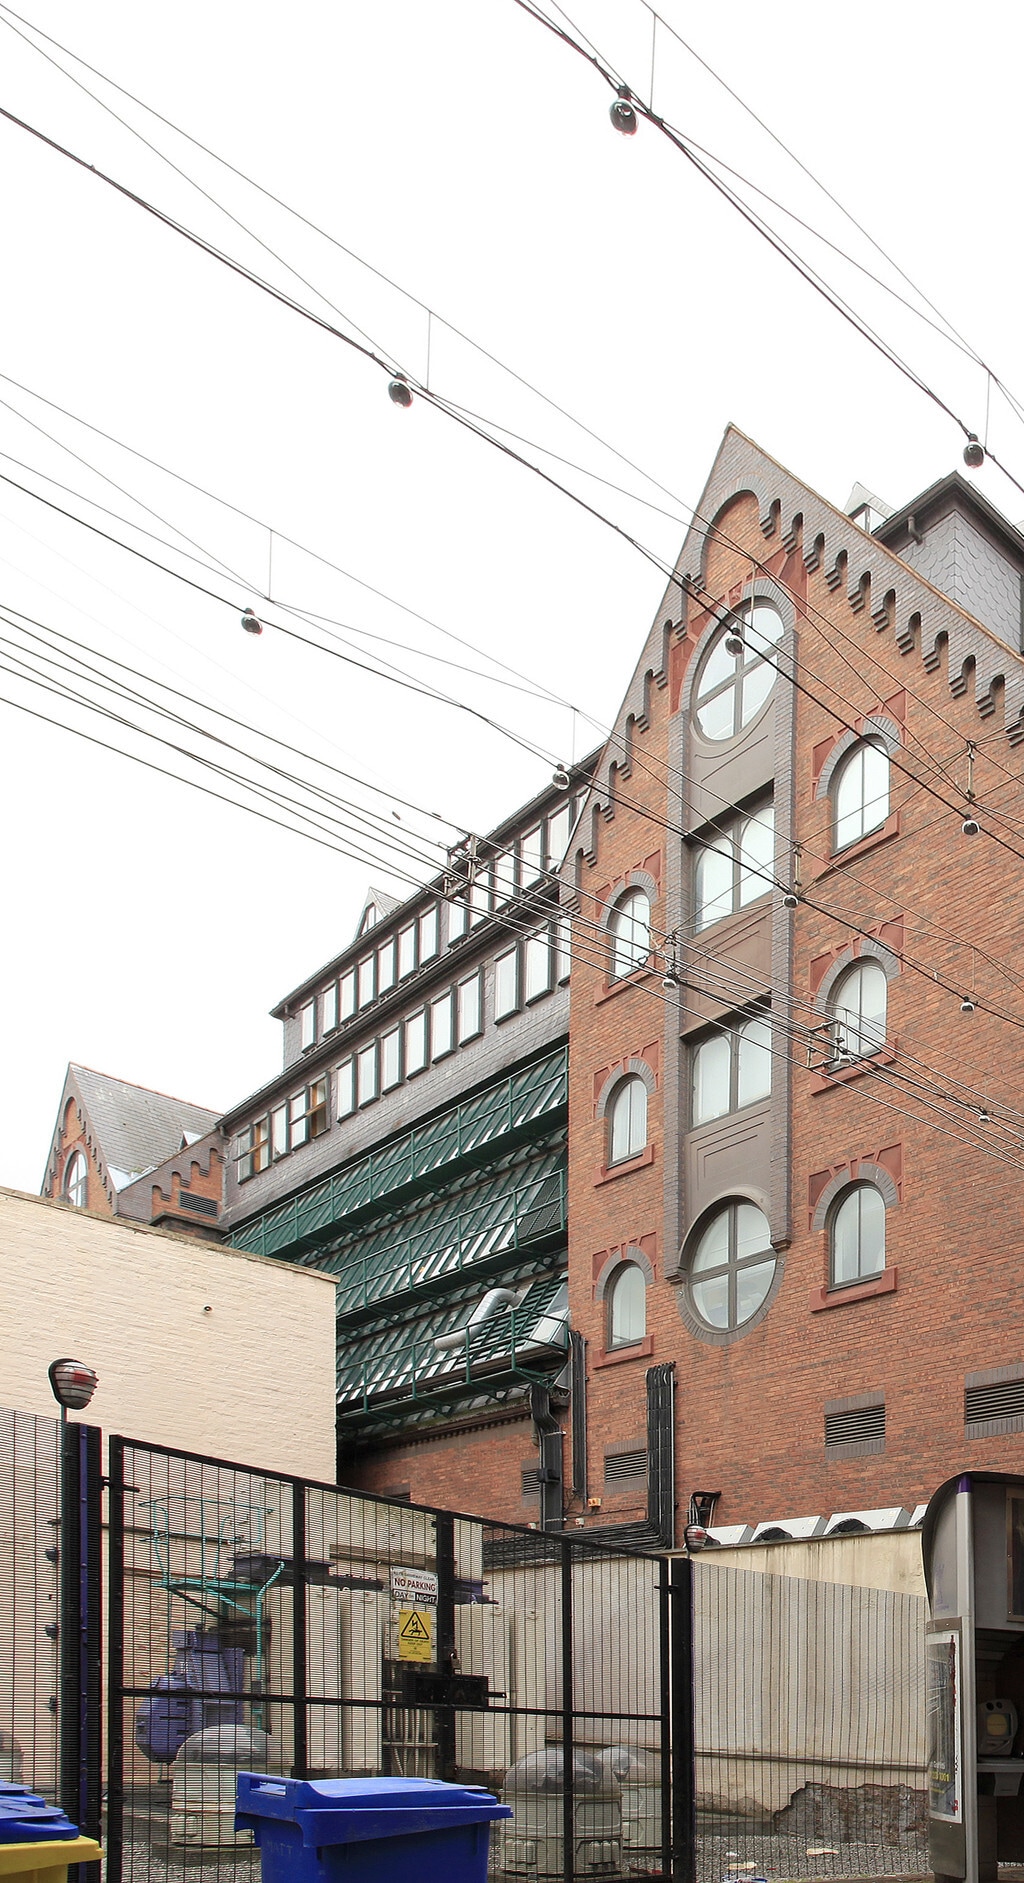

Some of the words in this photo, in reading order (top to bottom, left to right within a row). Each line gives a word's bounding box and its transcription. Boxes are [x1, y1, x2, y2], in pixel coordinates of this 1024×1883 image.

[394, 1577, 406, 1587] NO
[407, 1580, 436, 1592] PARKING
[394, 1590, 409, 1599] DAY
[416, 1594, 437, 1603] NIGHT
